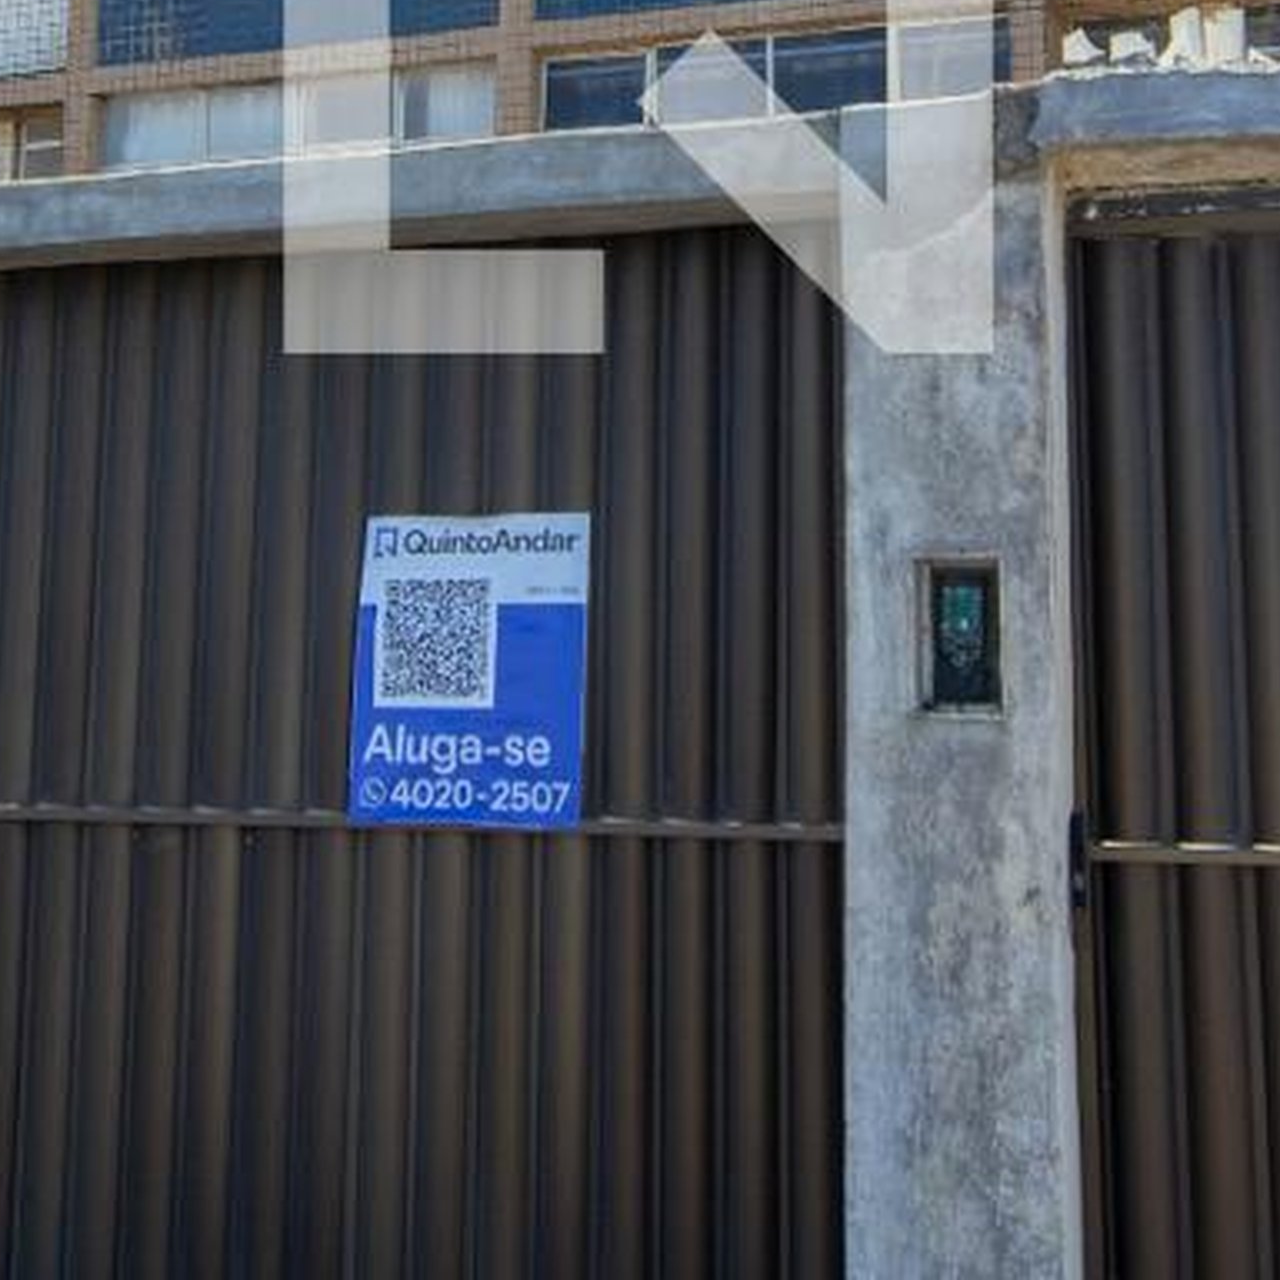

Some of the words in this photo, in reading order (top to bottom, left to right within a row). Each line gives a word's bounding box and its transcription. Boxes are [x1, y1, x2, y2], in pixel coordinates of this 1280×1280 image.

[403, 528, 581, 555] QuintoAndar
[363, 724, 552, 775] Aluga-se
[390, 779, 571, 813] 4020-2507
